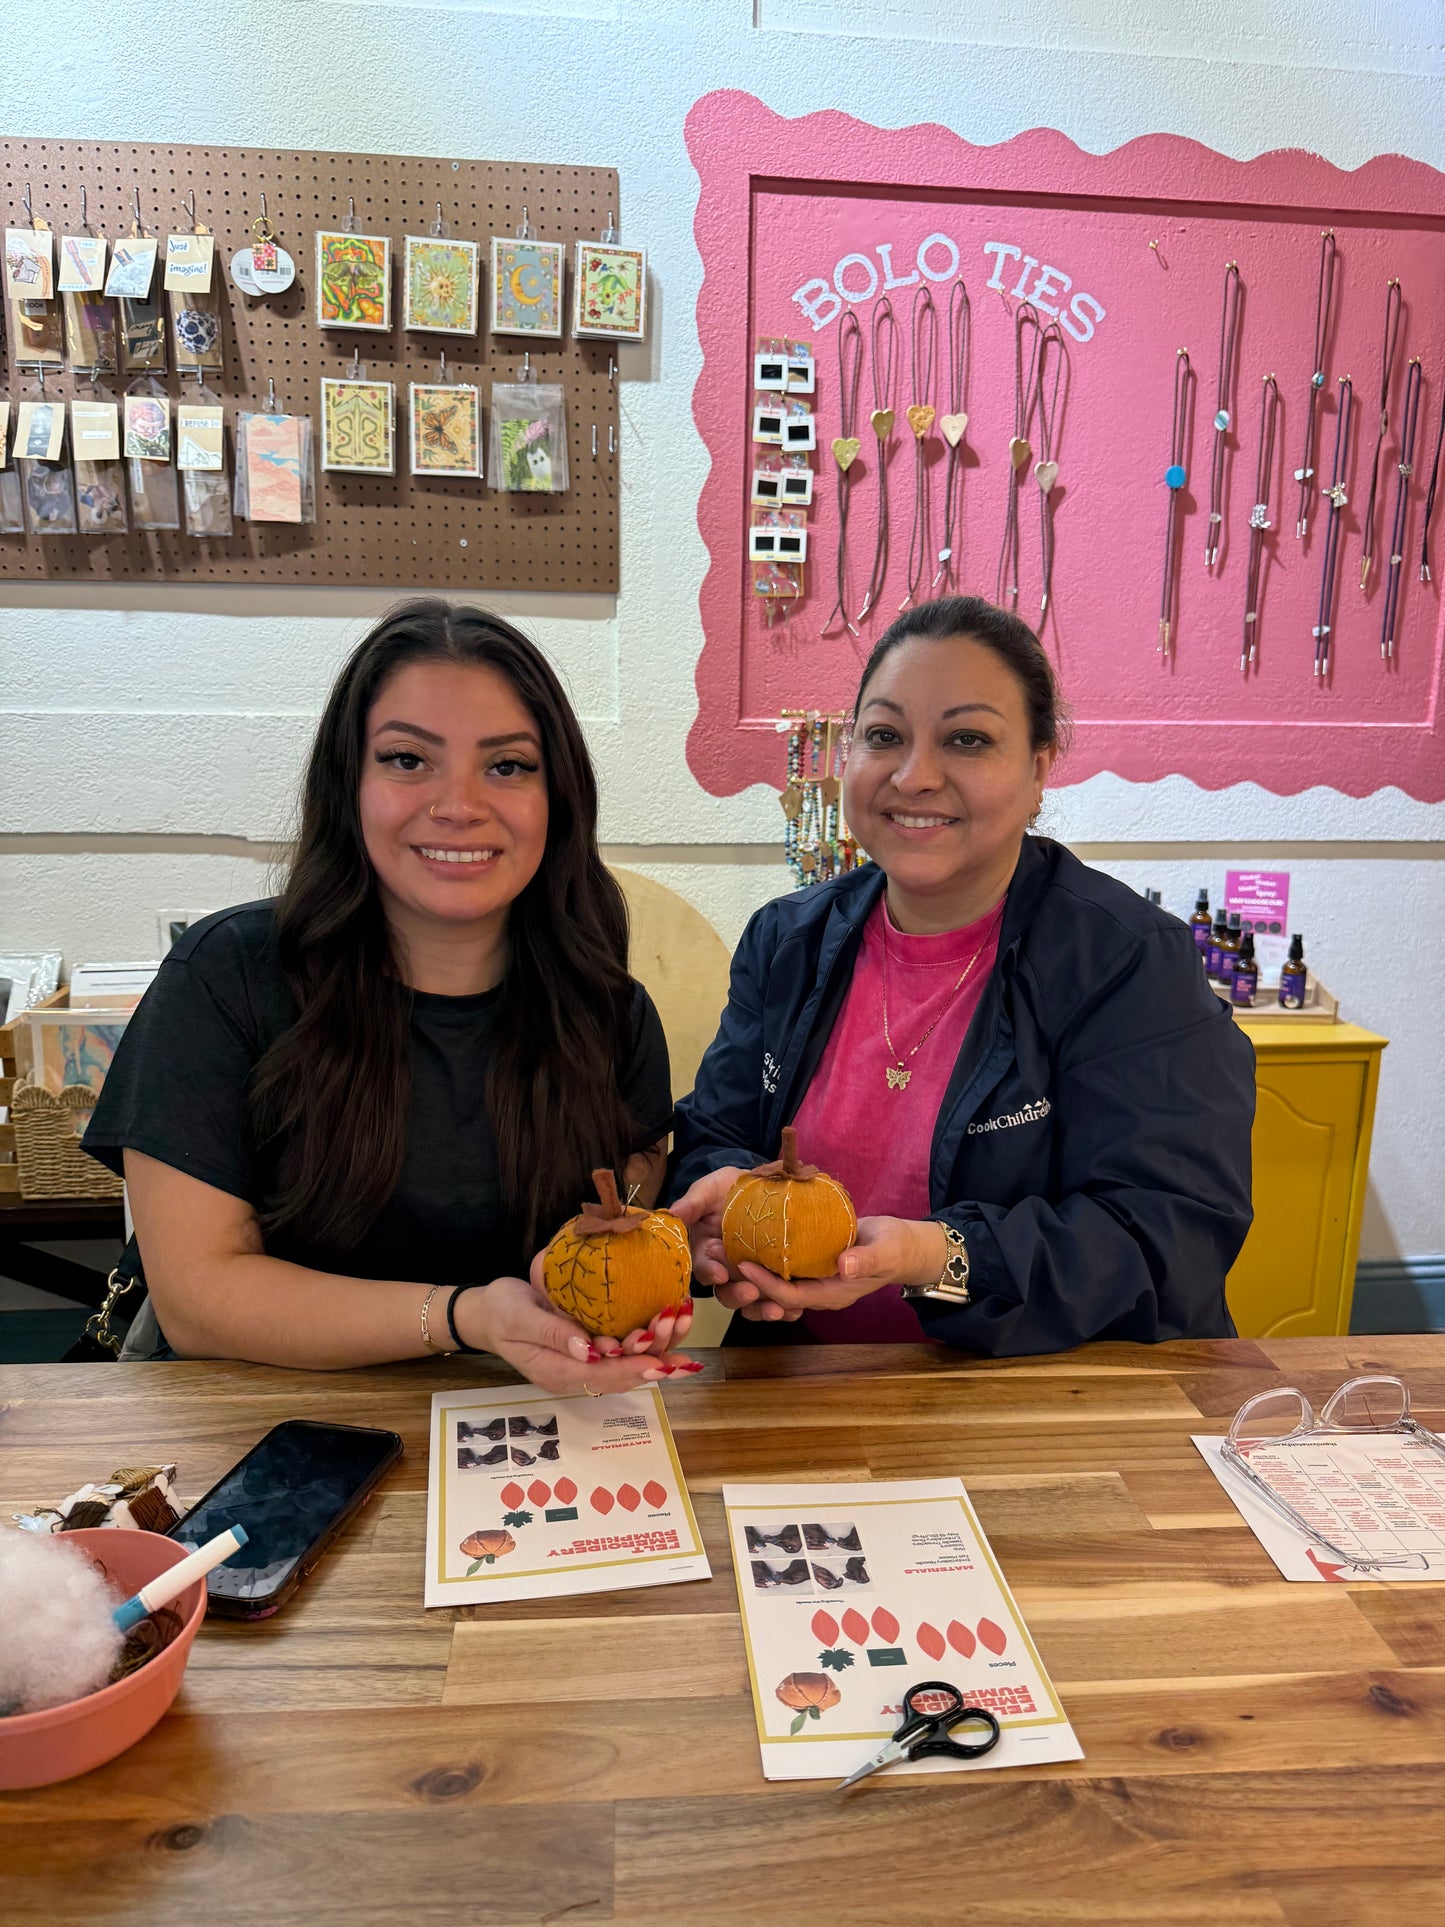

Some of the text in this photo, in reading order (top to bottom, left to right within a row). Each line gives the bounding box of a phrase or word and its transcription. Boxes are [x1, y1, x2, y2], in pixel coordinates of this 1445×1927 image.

[170, 240, 187, 252] Just
[170, 263, 207, 276] imagine!
[792, 233, 1106, 343] BOLO TIES
[592, 1440, 652, 1450] MATERIALS
[572, 1529, 676, 1548] PUMPKINS
[547, 1536, 678, 1557] EMBROIDERY
[632, 1542, 680, 1554] FELT
[904, 1565, 974, 1574] MATERIALS
